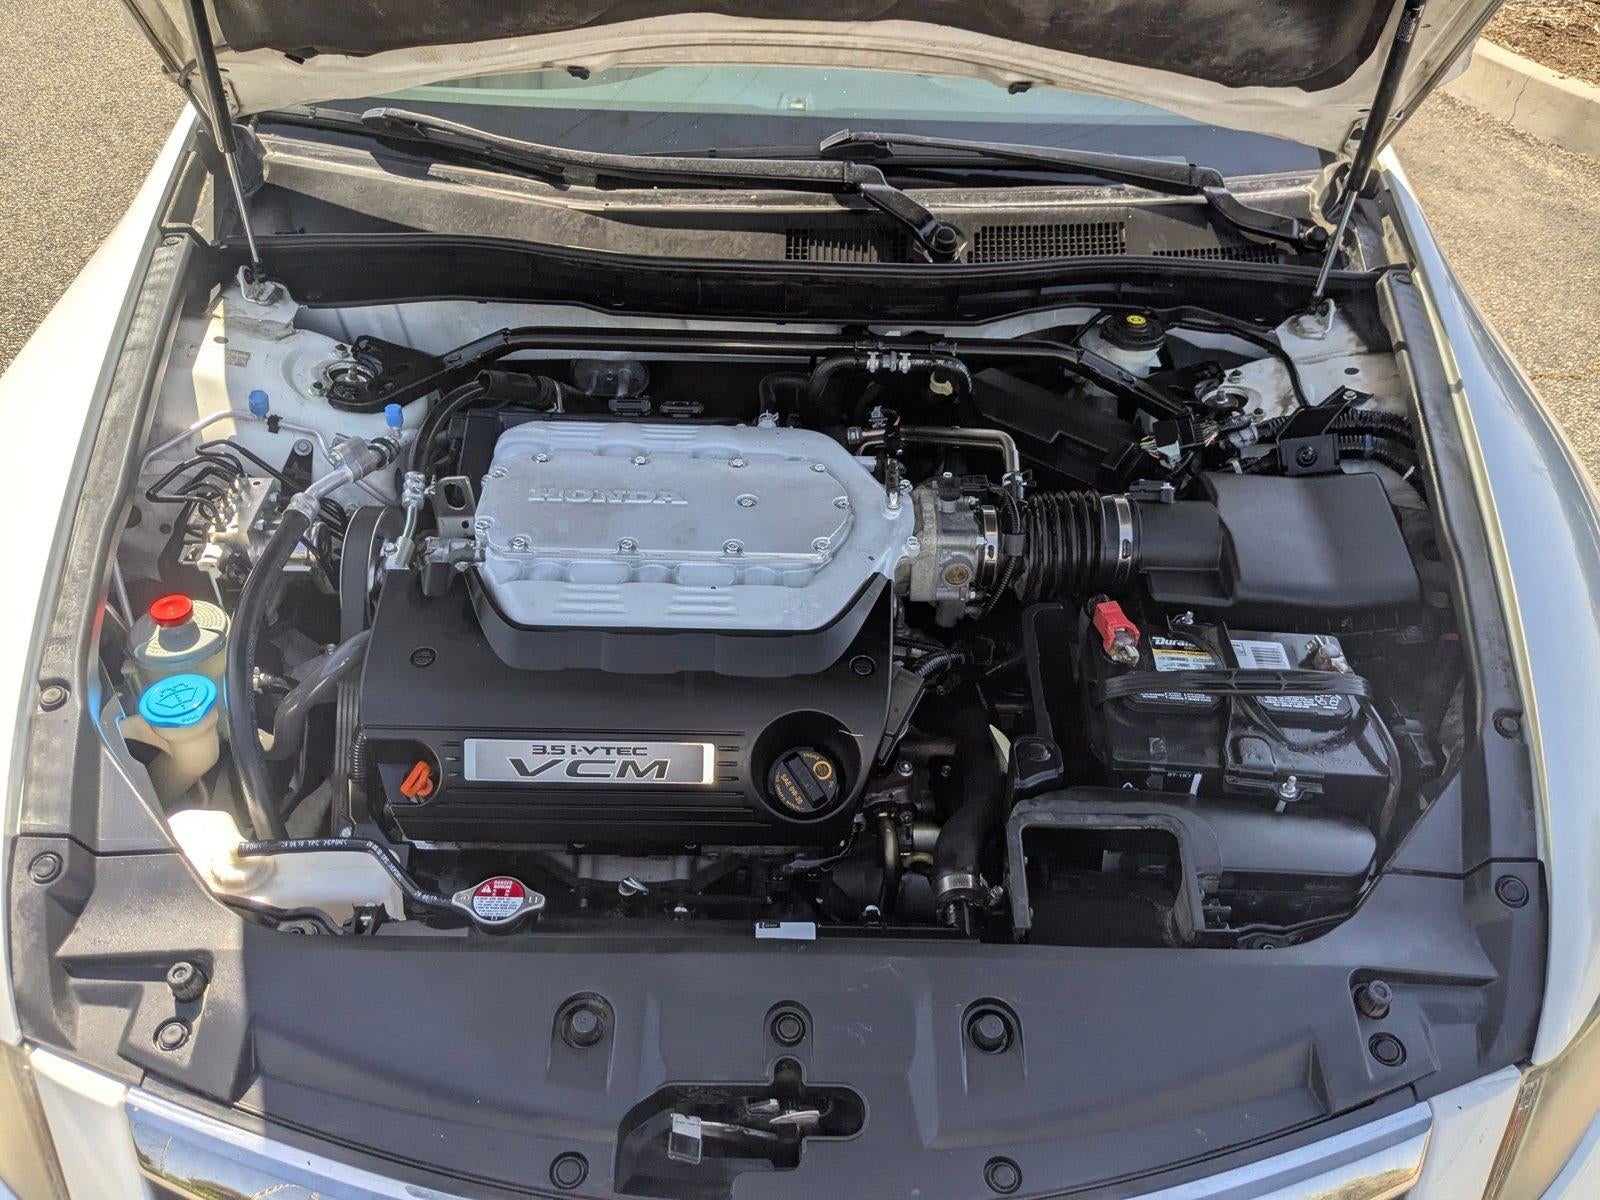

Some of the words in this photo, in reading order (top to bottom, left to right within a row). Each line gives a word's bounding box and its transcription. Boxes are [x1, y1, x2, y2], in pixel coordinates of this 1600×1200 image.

[529, 488, 688, 504] HONDA
[1152, 636, 1196, 646] Dura
[532, 744, 566, 756] 3.5
[570, 744, 648, 757] i-VTEC
[509, 758, 671, 780] VCM
[780, 773, 792, 787] SAE
